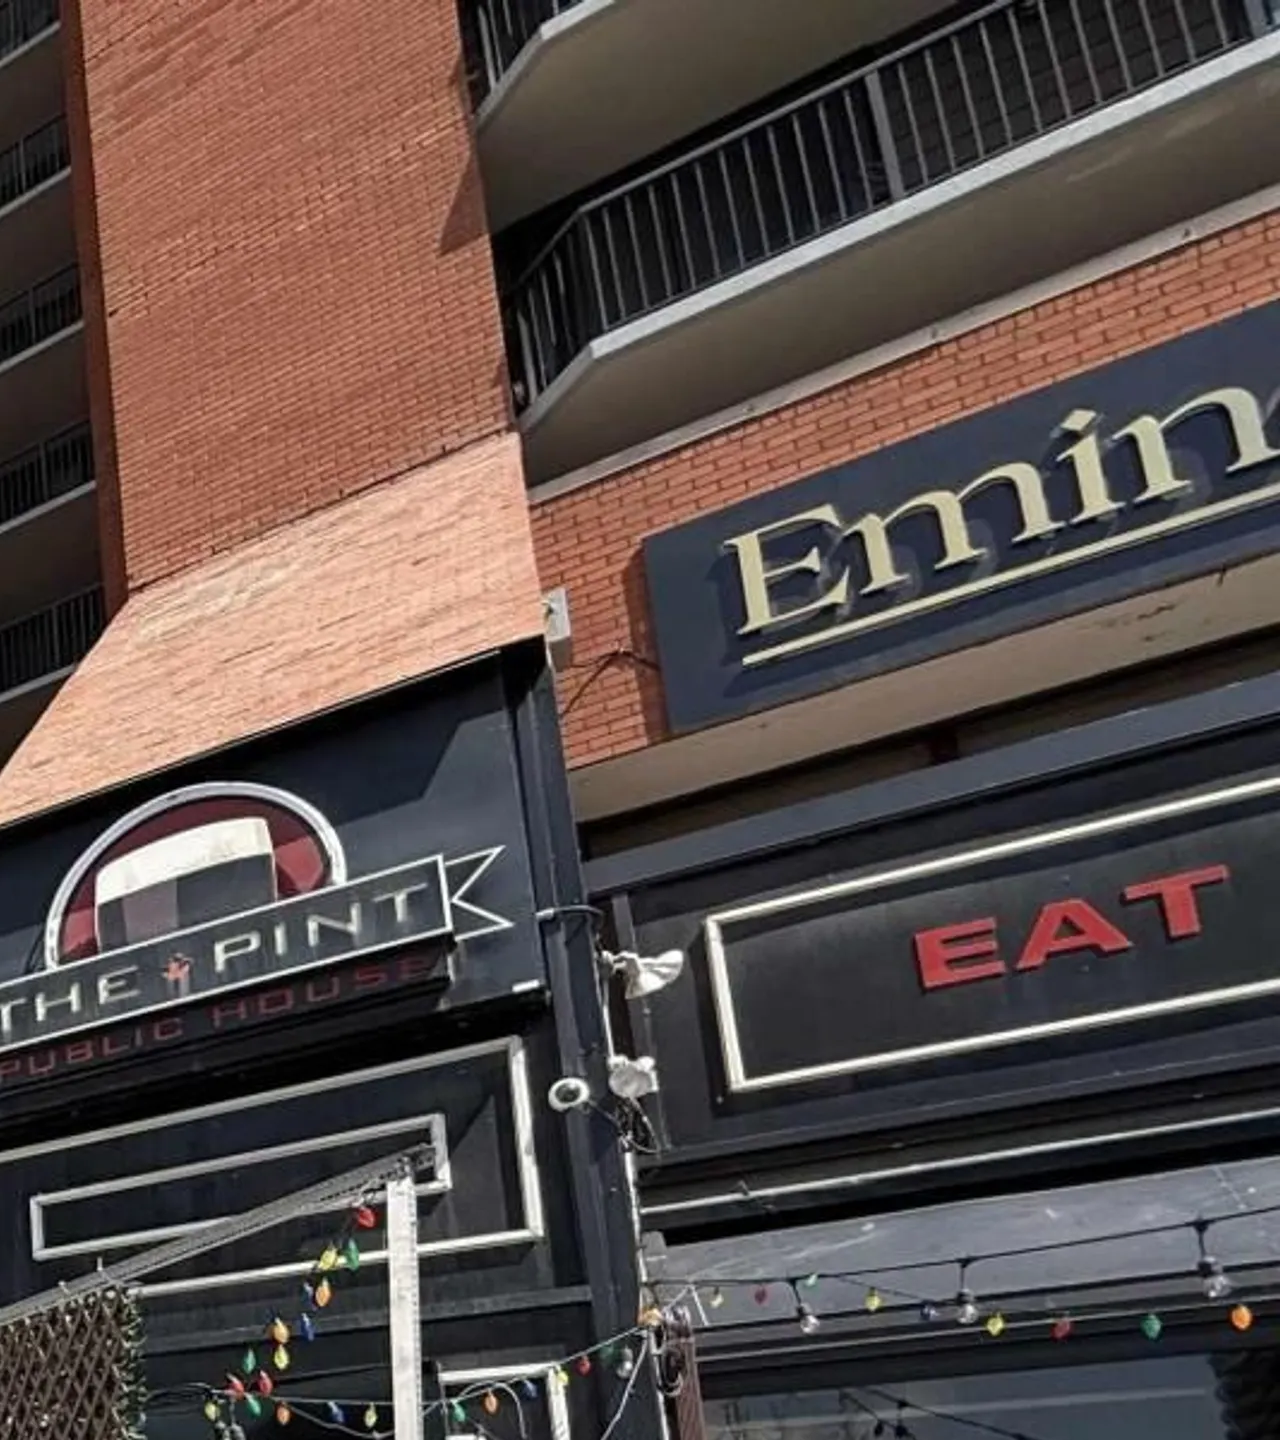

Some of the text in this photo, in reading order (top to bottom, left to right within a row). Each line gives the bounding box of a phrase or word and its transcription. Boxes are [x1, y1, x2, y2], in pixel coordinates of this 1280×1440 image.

[720, 387, 1280, 635] Emin
[213, 882, 429, 974] PINT
[913, 863, 1232, 990] EAT
[211, 956, 437, 1028] HOUSE
